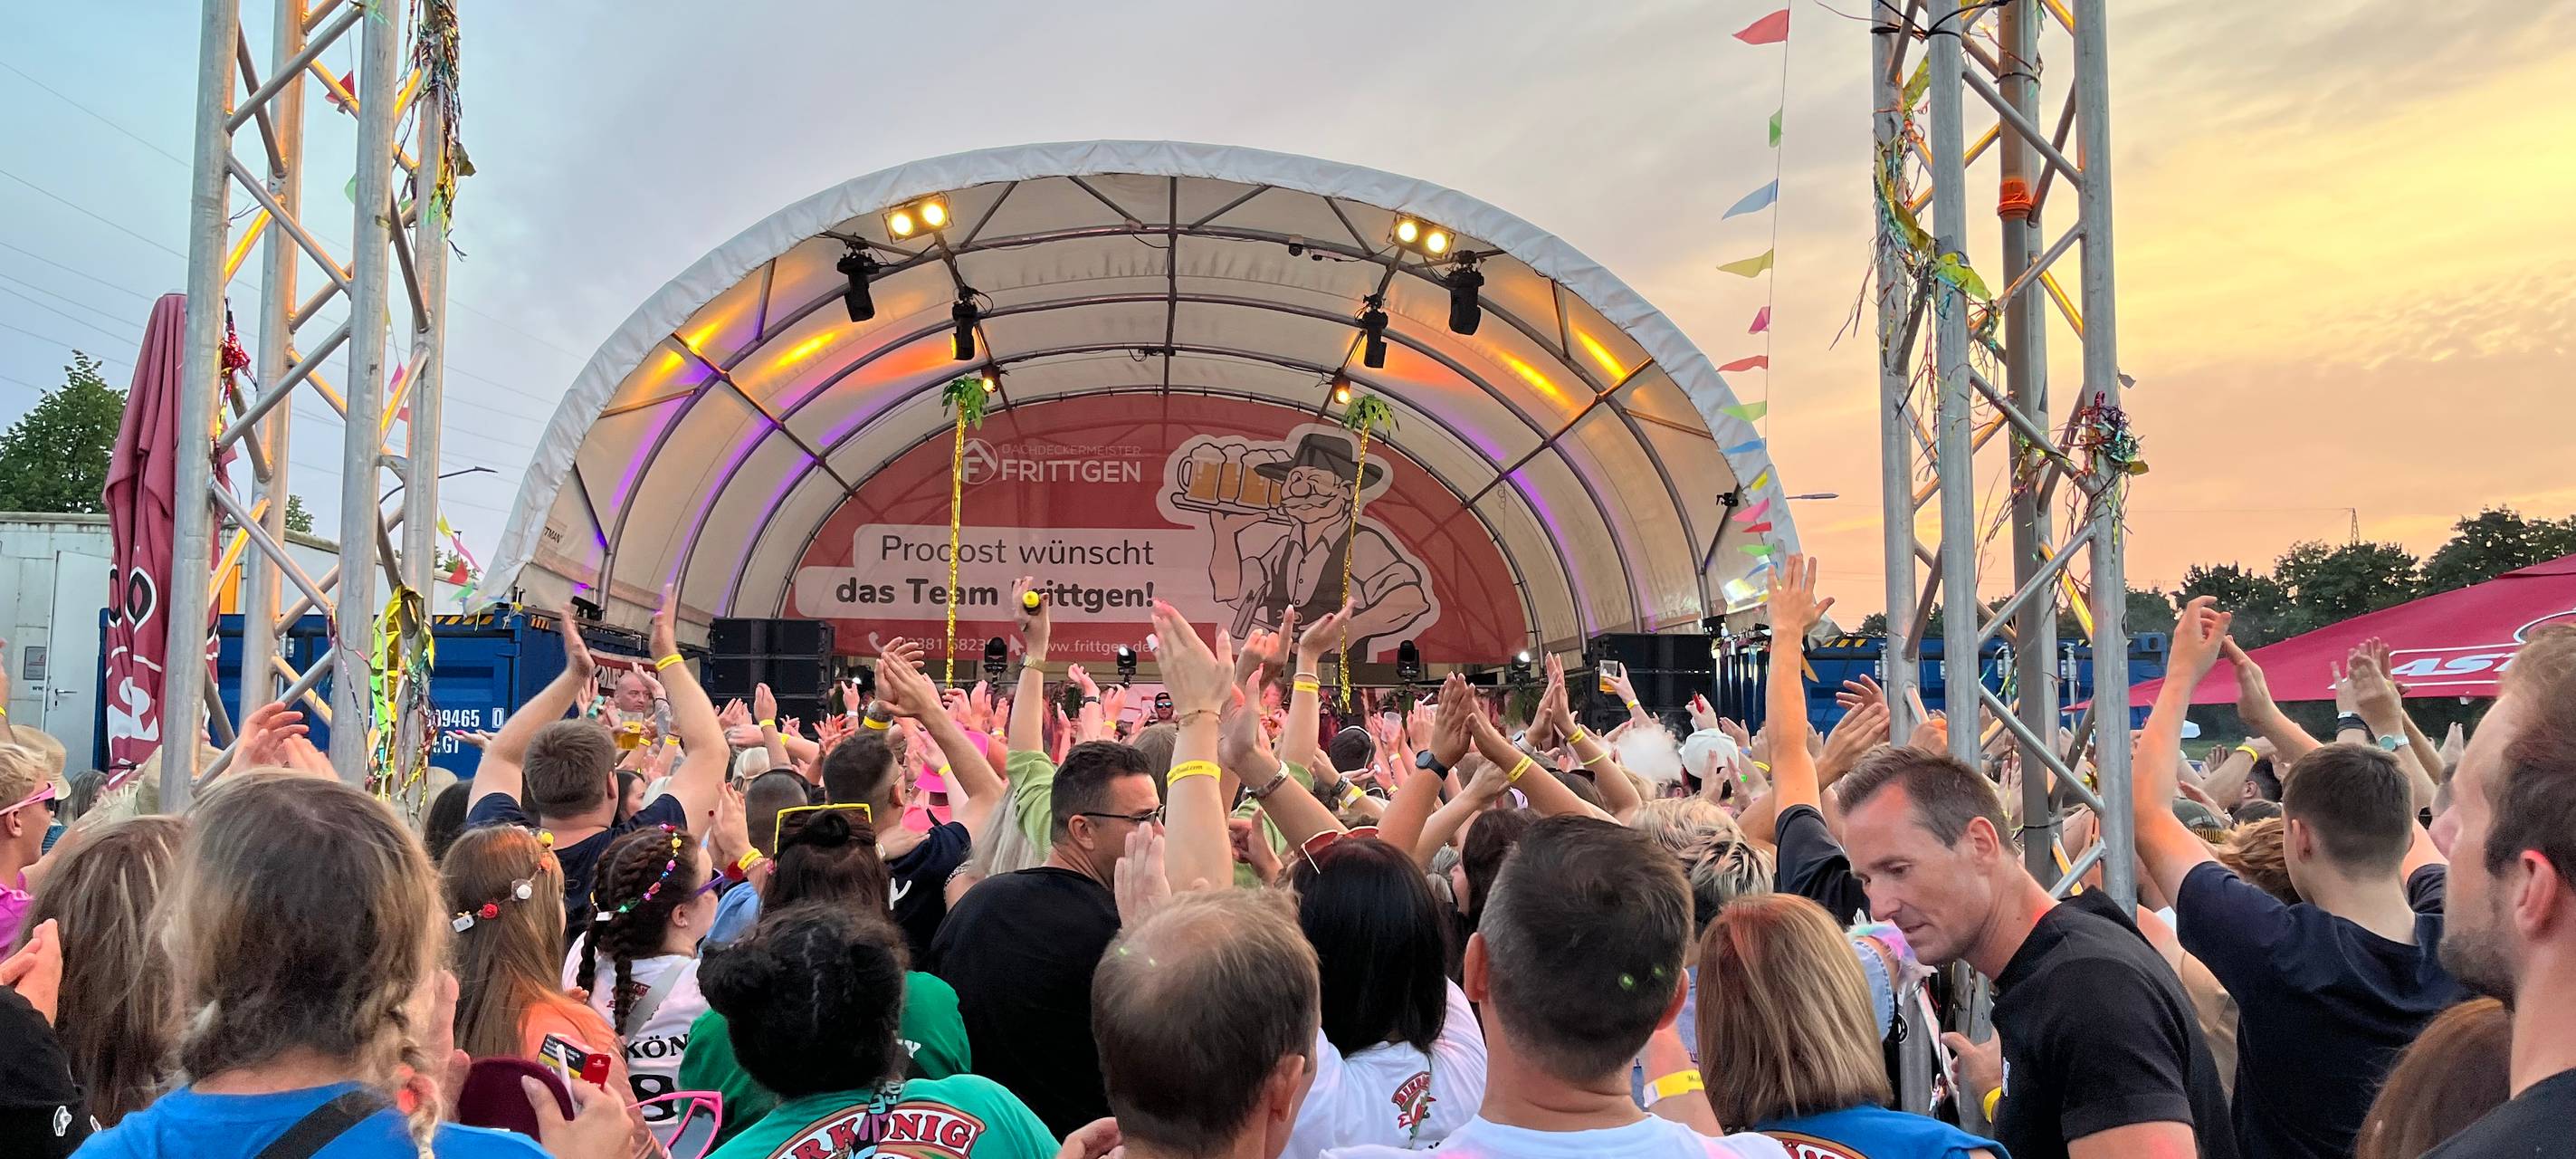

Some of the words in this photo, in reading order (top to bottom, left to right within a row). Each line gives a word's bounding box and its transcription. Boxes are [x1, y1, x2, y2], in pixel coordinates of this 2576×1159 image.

[1002, 444, 1141, 455] DACHDECKERMEISTER
[1002, 459, 1141, 483] FRITTGEN
[1019, 539, 1154, 566] wünscht
[835, 577, 895, 604] das
[905, 578, 998, 606] Team
[1011, 580, 1154, 613] rittgen!
